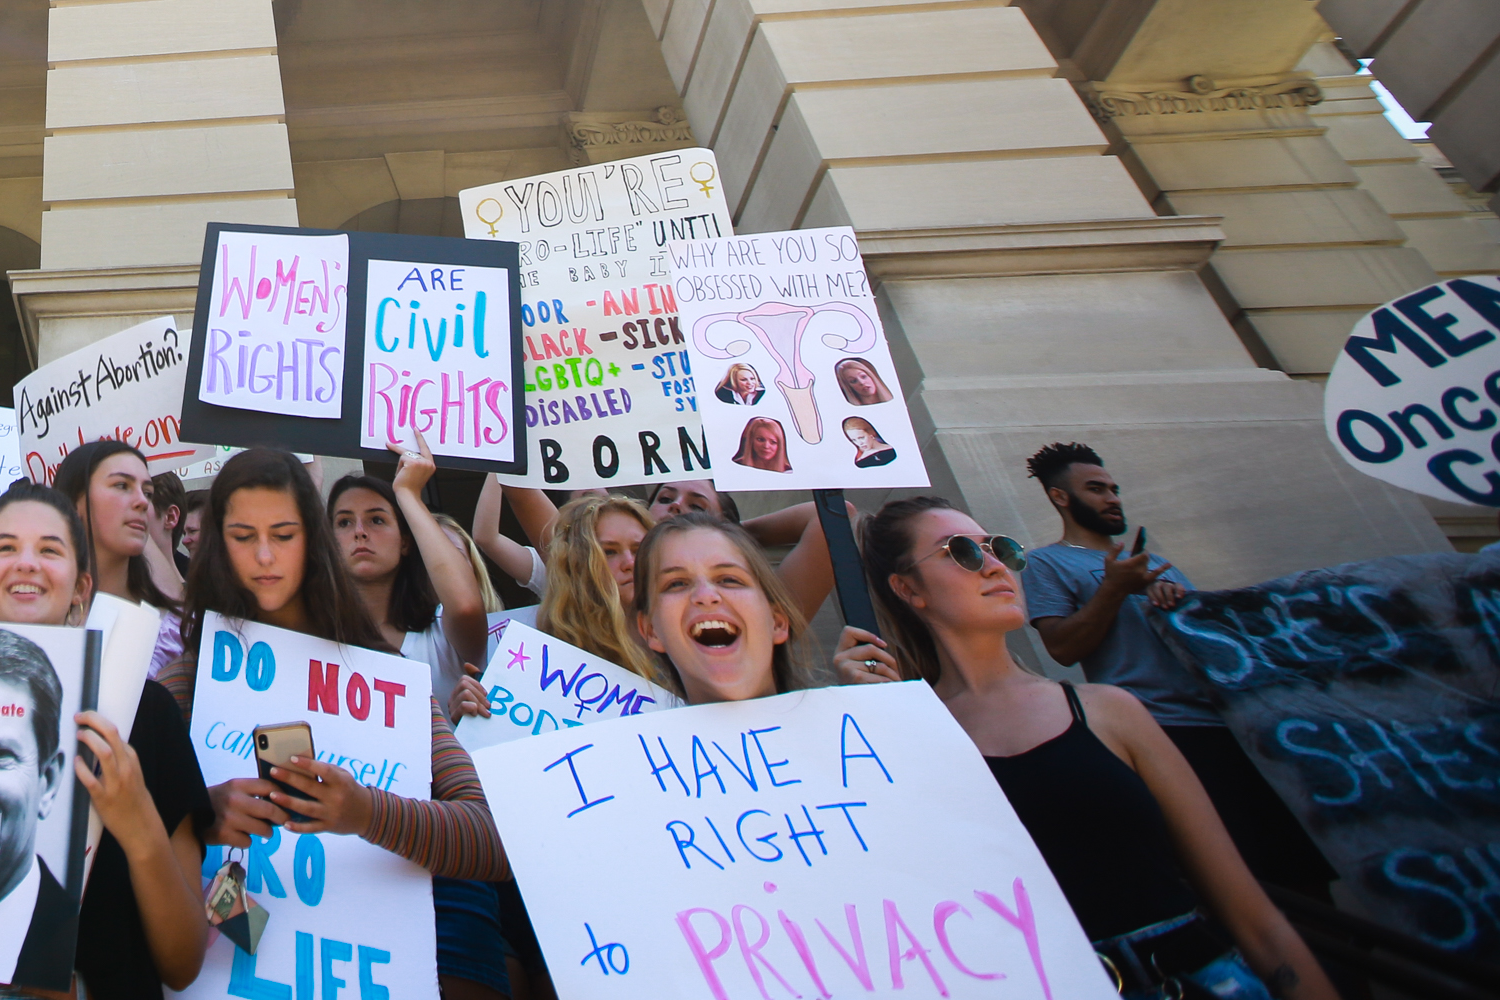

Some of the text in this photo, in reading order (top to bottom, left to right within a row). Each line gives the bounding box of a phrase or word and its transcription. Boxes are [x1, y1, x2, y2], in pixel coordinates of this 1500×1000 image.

[504, 155, 689, 233] YOU'RE
[519, 221, 643, 267] RO-LIFE"
[668, 234, 858, 269] WHY ARE YOU SO
[397, 268, 465, 292] ARE
[569, 260, 627, 282] BABY
[676, 270, 867, 302] OBSESSED WITH ME?
[521, 299, 569, 327] OOR
[523, 328, 593, 362] LACK
[20, 328, 183, 439] Against Abortion?
[145, 415, 182, 447] on
[539, 425, 711, 484] BORN
[212, 630, 406, 729] DO NOT
[540, 644, 656, 717] WOME
[486, 685, 584, 736] BOD
[543, 713, 894, 818] I HAVE A
[666, 801, 868, 870] RIGHT
[581, 922, 630, 976] to
